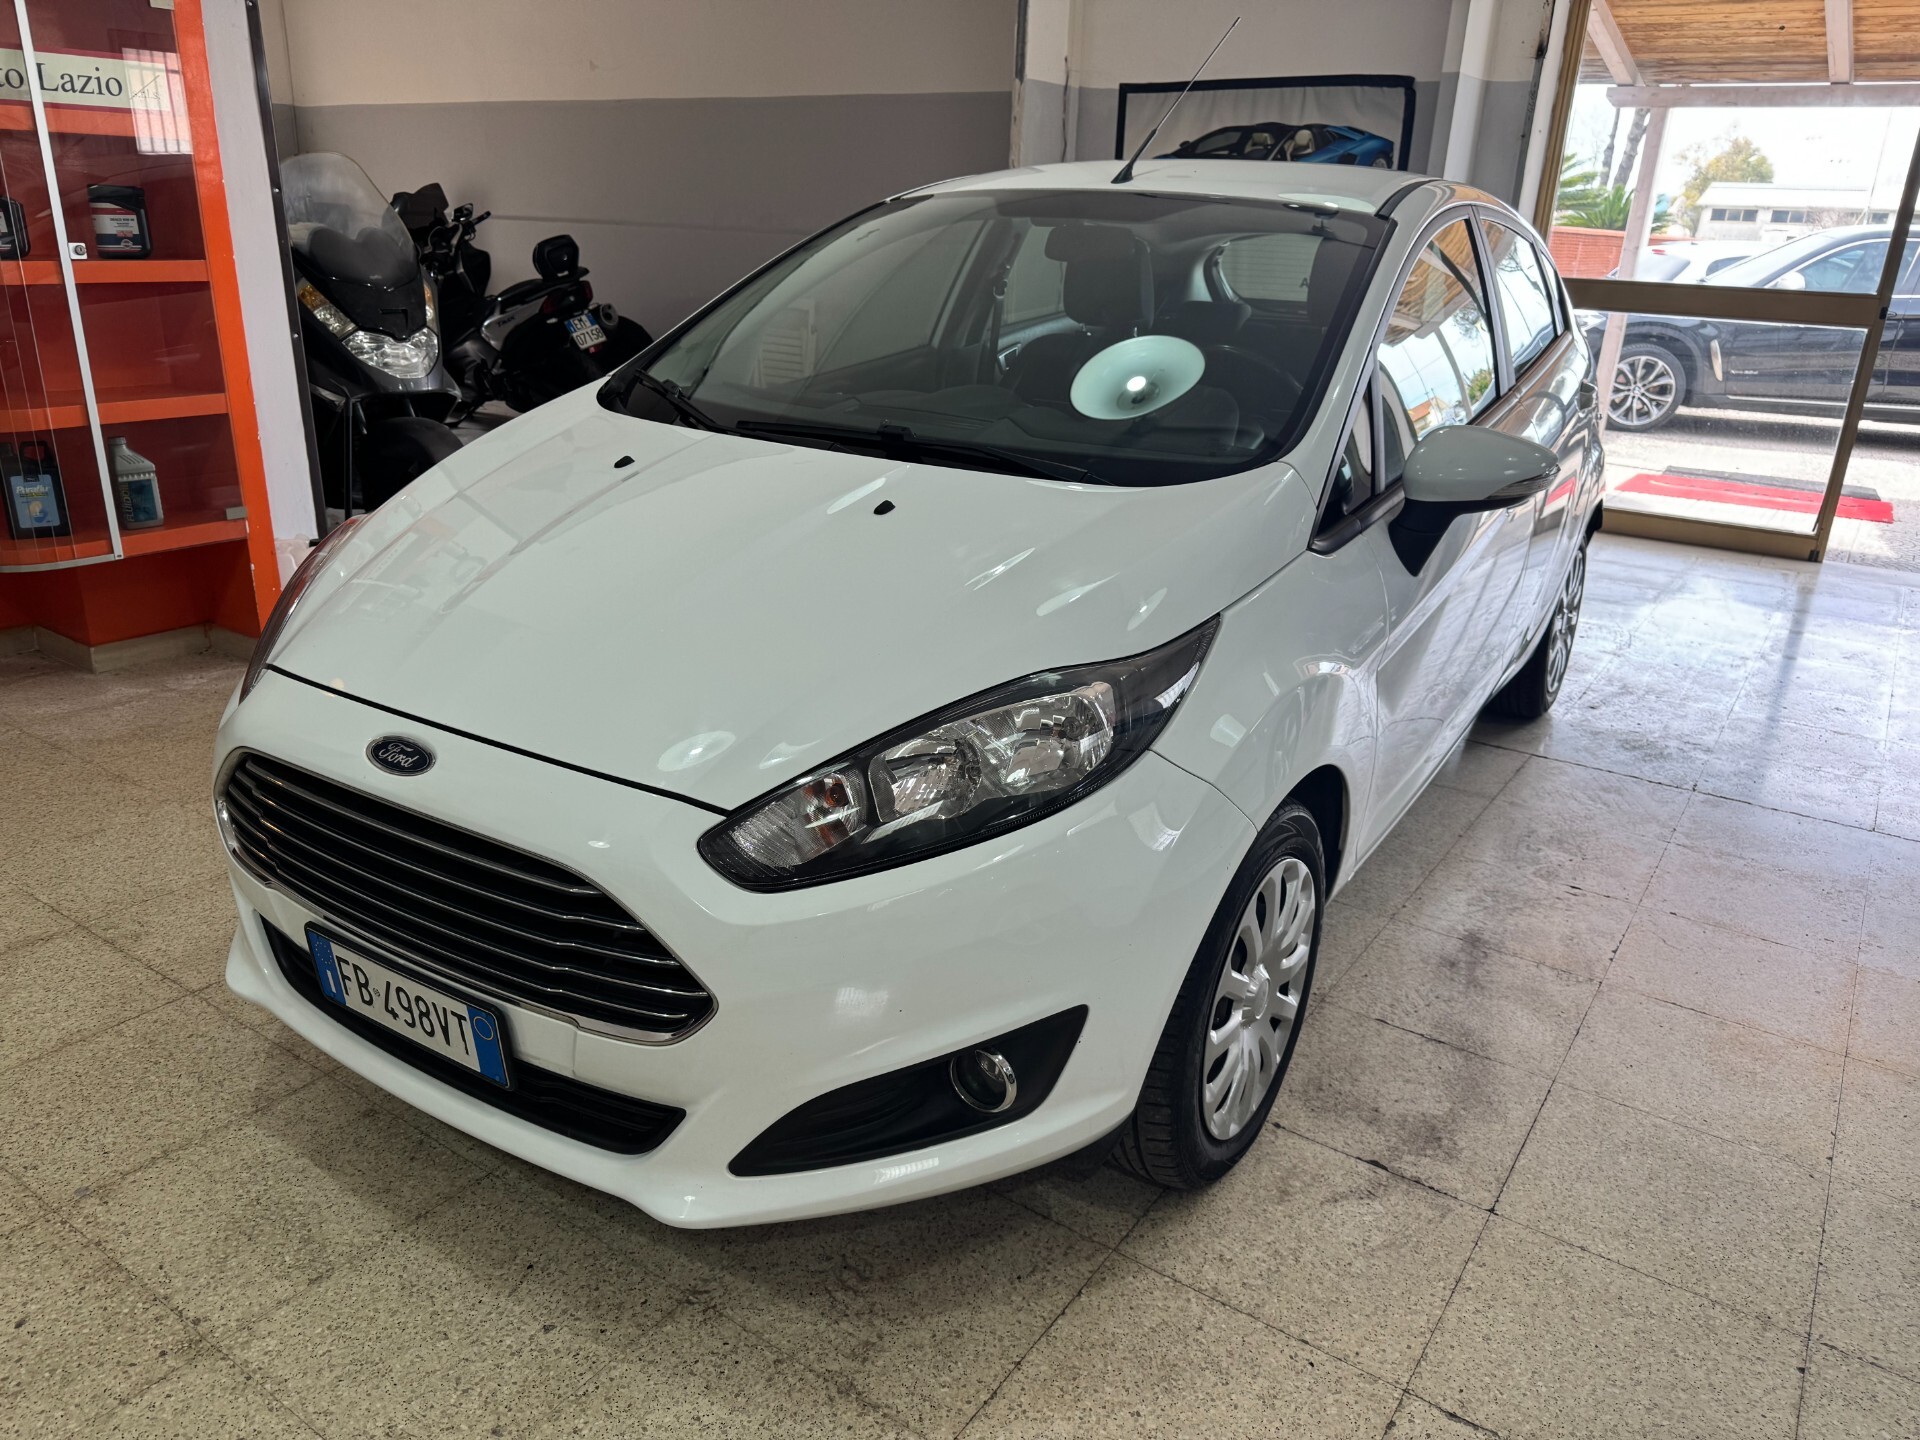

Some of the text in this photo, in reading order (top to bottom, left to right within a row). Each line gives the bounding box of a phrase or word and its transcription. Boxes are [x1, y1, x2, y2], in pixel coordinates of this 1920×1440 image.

[36, 62, 123, 97] Lazio
[575, 327, 604, 346] 07158
[16, 485, 49, 494] Paraflu
[378, 742, 420, 768] Ford
[335, 955, 374, 1006] FB
[384, 980, 469, 1055] 498VT
